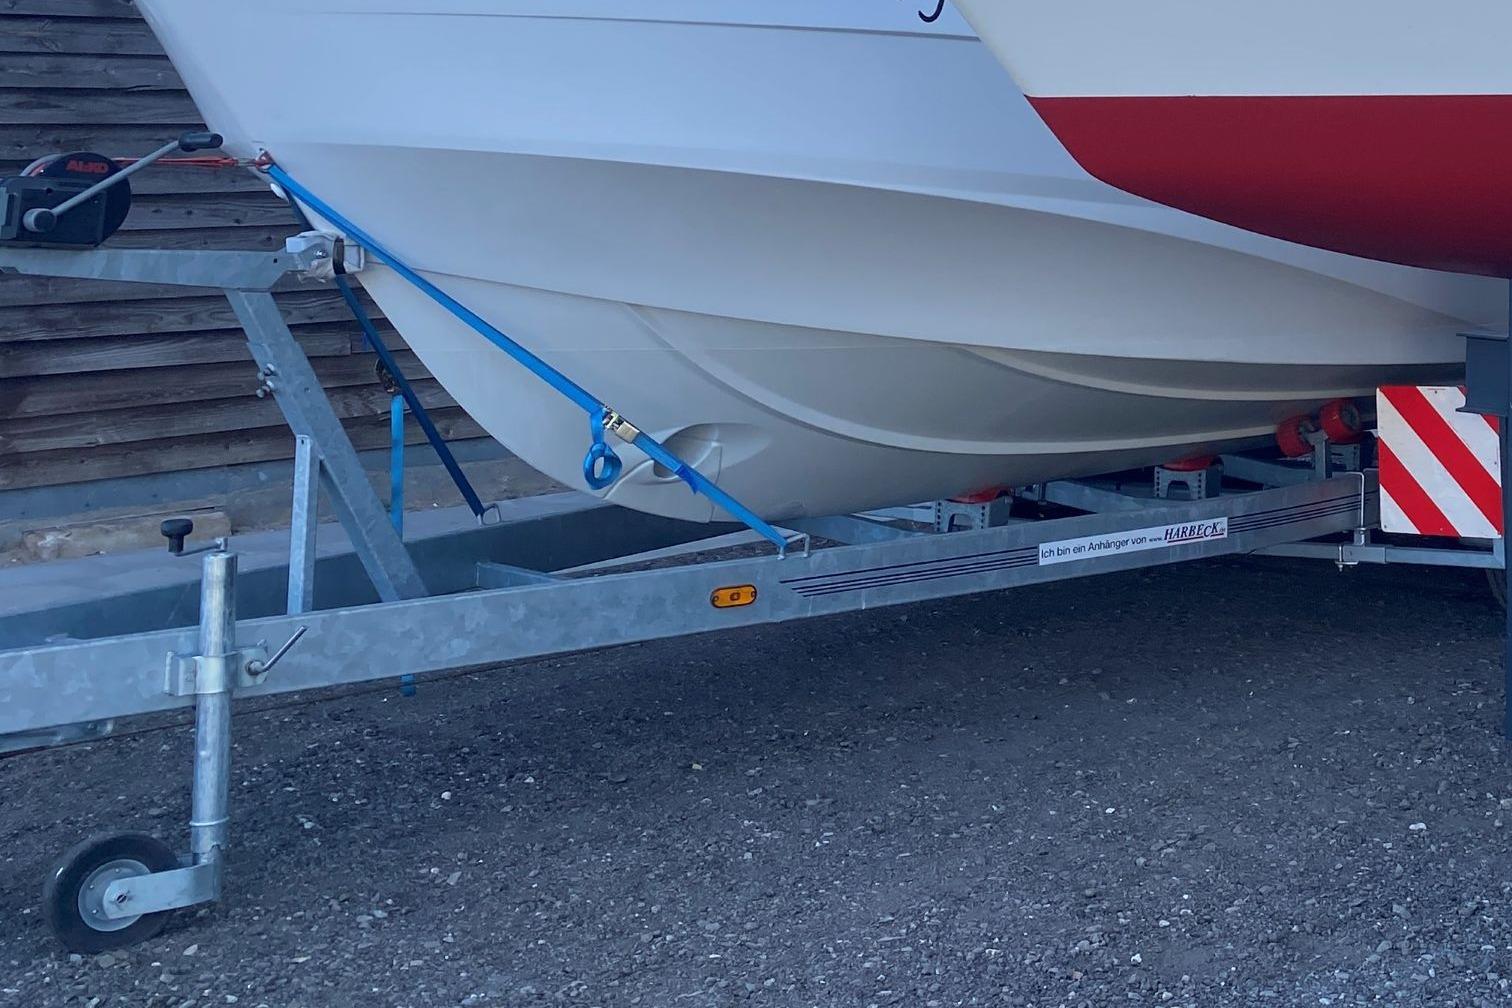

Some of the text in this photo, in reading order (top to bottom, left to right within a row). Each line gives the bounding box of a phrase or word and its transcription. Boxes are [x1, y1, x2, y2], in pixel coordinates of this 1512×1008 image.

[1041, 548, 1055, 559] Ich
[1057, 546, 1071, 556] bin
[1072, 545, 1086, 554] ein
[1087, 537, 1130, 550] Anhänger
[1131, 536, 1147, 544] von
